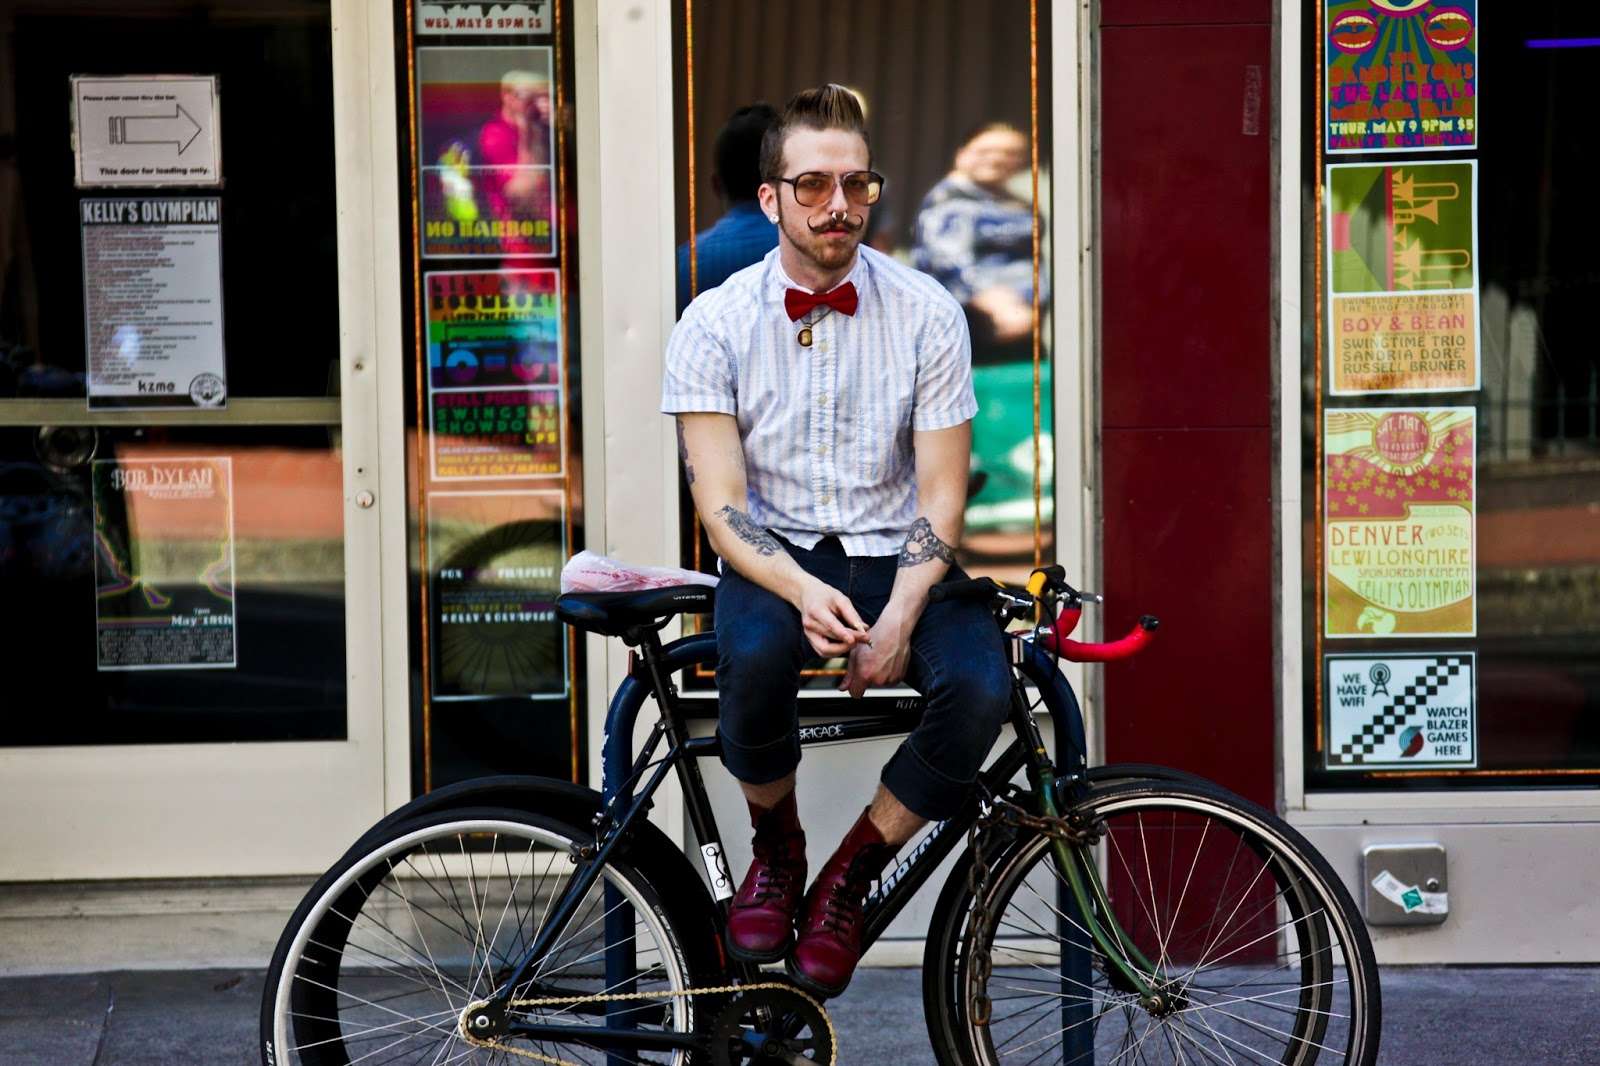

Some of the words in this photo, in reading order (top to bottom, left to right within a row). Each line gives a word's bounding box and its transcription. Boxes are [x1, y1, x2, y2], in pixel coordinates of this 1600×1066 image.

[456, 18, 481, 29] MAY
[1373, 120, 1405, 133] MAY
[1409, 120, 1417, 132] 9
[1421, 119, 1453, 132] 9PM
[1457, 117, 1474, 132] $5
[100, 167, 118, 175] This
[120, 167, 139, 175] door
[142, 167, 154, 175] for
[156, 167, 187, 176] loading
[83, 202, 138, 223] KELLY'S
[141, 200, 217, 222] OLYMPIAN
[427, 220, 455, 237] NO
[459, 220, 549, 237] HARBOR
[1343, 318, 1382, 332] BOY
[1390, 316, 1402, 331] &
[1411, 314, 1465, 330] BEAN
[1343, 335, 1426, 350] SWINGTIME
[1433, 335, 1466, 347] TRIO
[1343, 348, 1413, 361] SANDRIA
[1343, 362, 1404, 374] RUSSELL
[1410, 360, 1467, 373] BRUNER
[111, 467, 147, 491] BOB
[152, 464, 213, 488] DYLAN
[1331, 525, 1424, 546] DENVER
[1330, 550, 1371, 566] LEWI
[1377, 549, 1469, 567] LONGMIRE
[171, 614, 197, 627] May
[1343, 673, 1361, 684] WE
[1337, 685, 1367, 695] HAVE
[1340, 697, 1365, 707] WIFI
[1427, 707, 1467, 717] WATCH
[1427, 719, 1468, 730] BLAZER
[1427, 732, 1468, 743] GAMES
[1435, 745, 1463, 756] HERE
